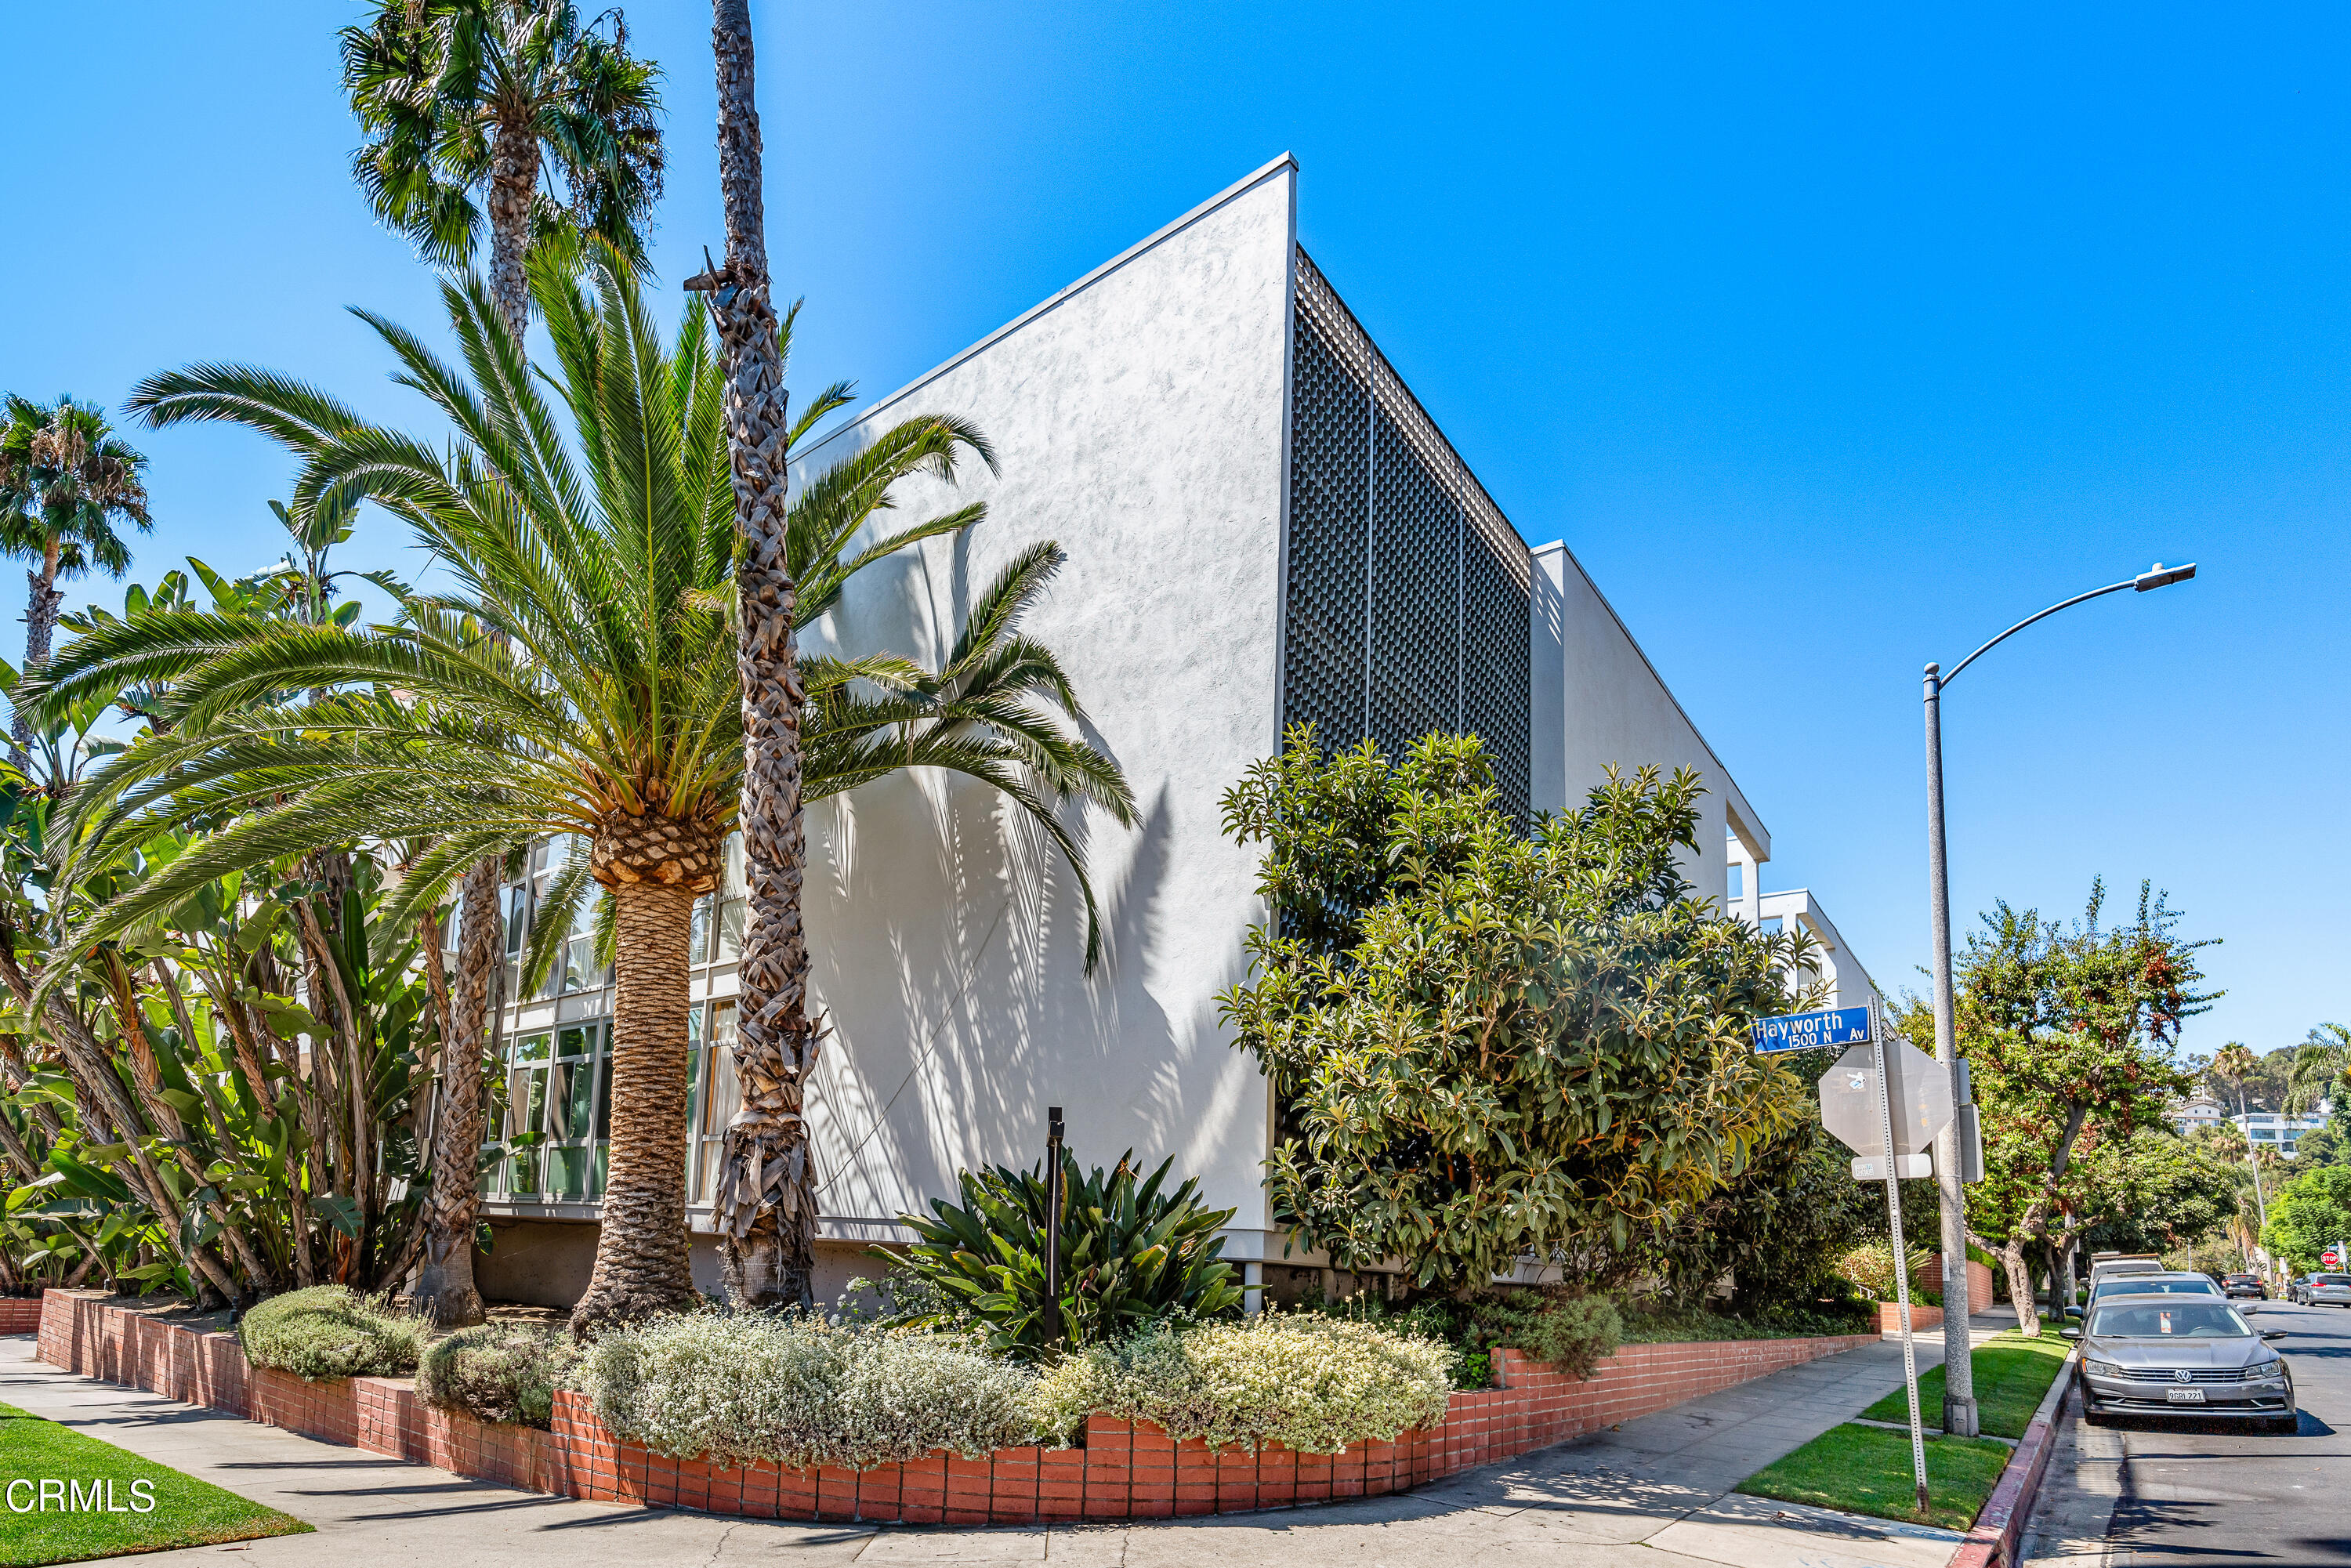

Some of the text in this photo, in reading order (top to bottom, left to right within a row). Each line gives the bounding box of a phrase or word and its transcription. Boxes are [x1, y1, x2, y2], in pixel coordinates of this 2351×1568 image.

[1756, 1012, 1842, 1040] Hayworth
[1788, 1028, 1864, 1048] 1500 N Av
